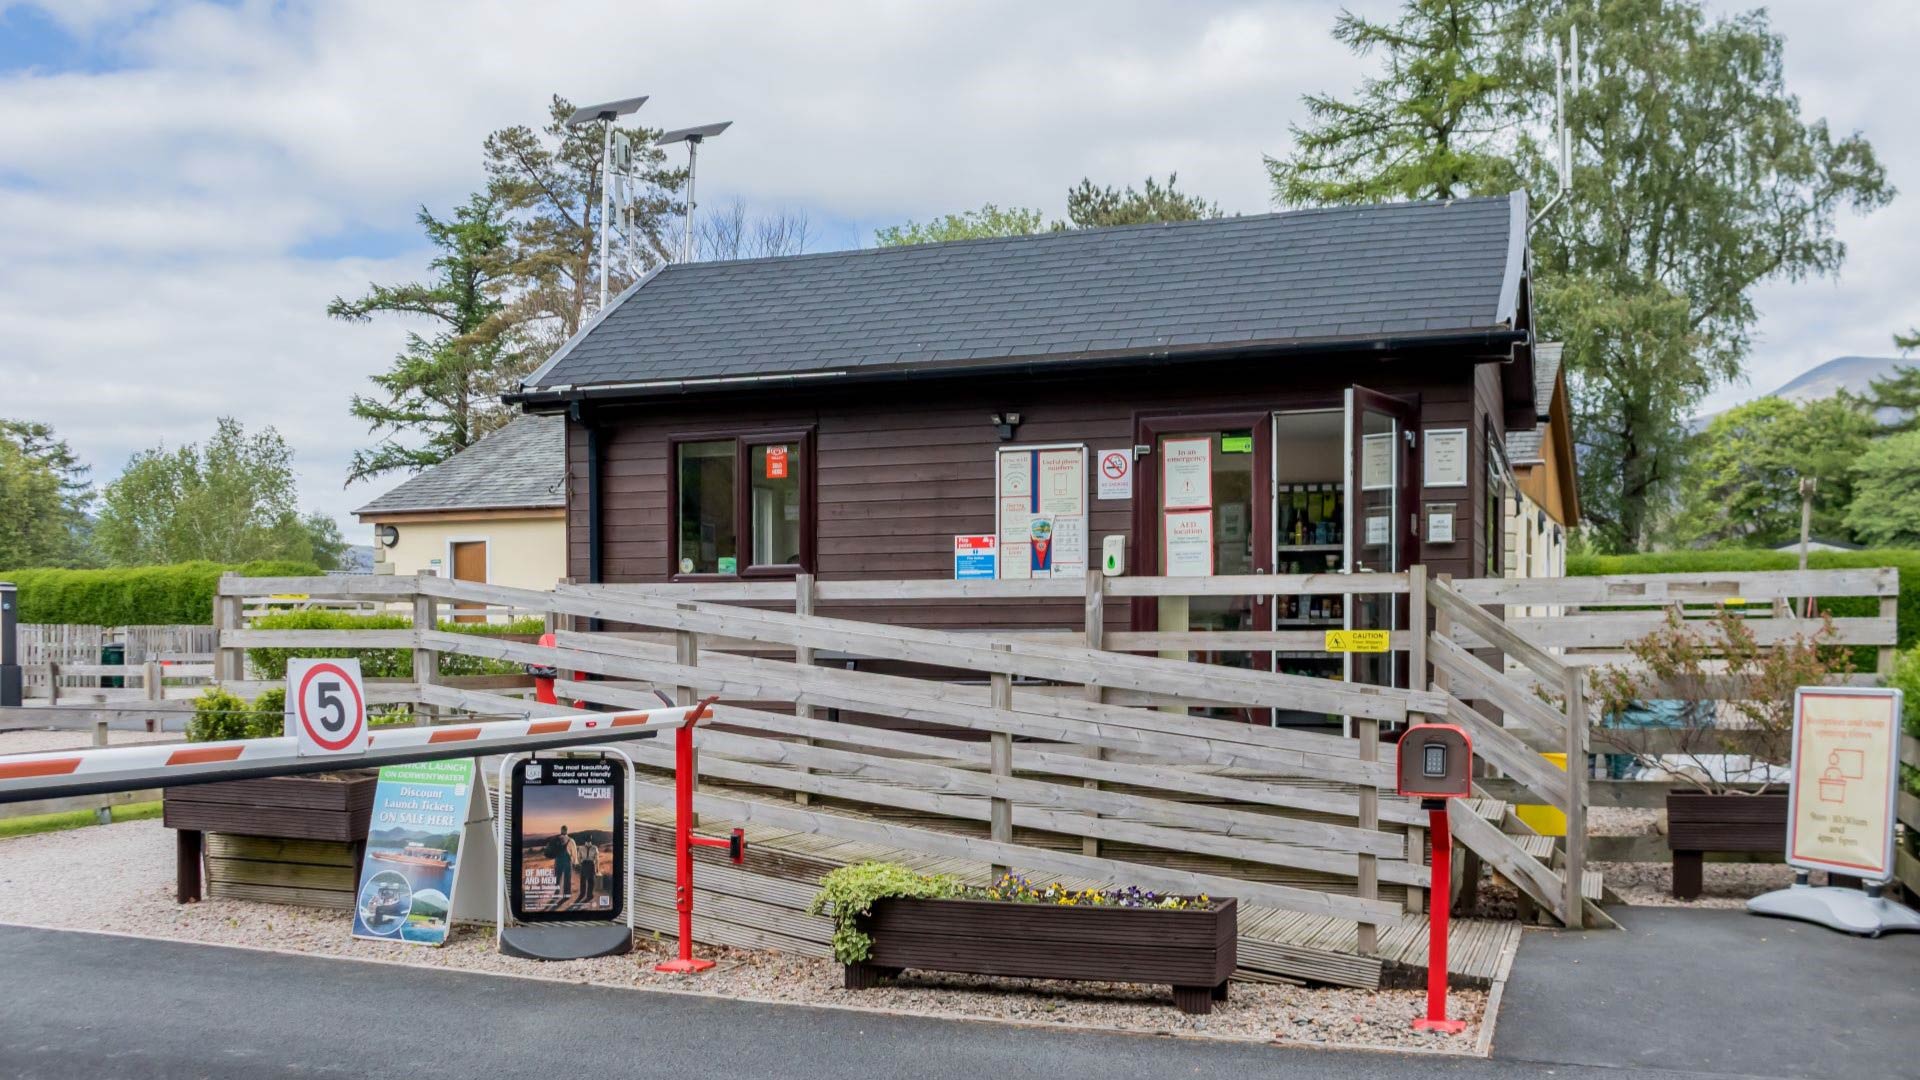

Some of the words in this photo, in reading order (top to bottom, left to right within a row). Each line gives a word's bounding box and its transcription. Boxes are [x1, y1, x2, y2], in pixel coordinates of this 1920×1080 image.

[1167, 455, 1207, 463] emergency
[317, 681, 346, 733] 5
[428, 762, 467, 772] LAUNCH
[385, 770, 397, 778] ON
[398, 771, 465, 782] DERWENTWATER
[400, 786, 443, 798] Discount
[384, 797, 418, 810] Launch
[419, 799, 455, 812] Tickets
[380, 811, 397, 824] ON
[400, 812, 425, 825] SALE
[427, 813, 456, 826] HERE
[525, 869, 534, 877] OF
[535, 869, 555, 877] MICE
[524, 877, 540, 885] AND
[541, 877, 557, 885] MEN
